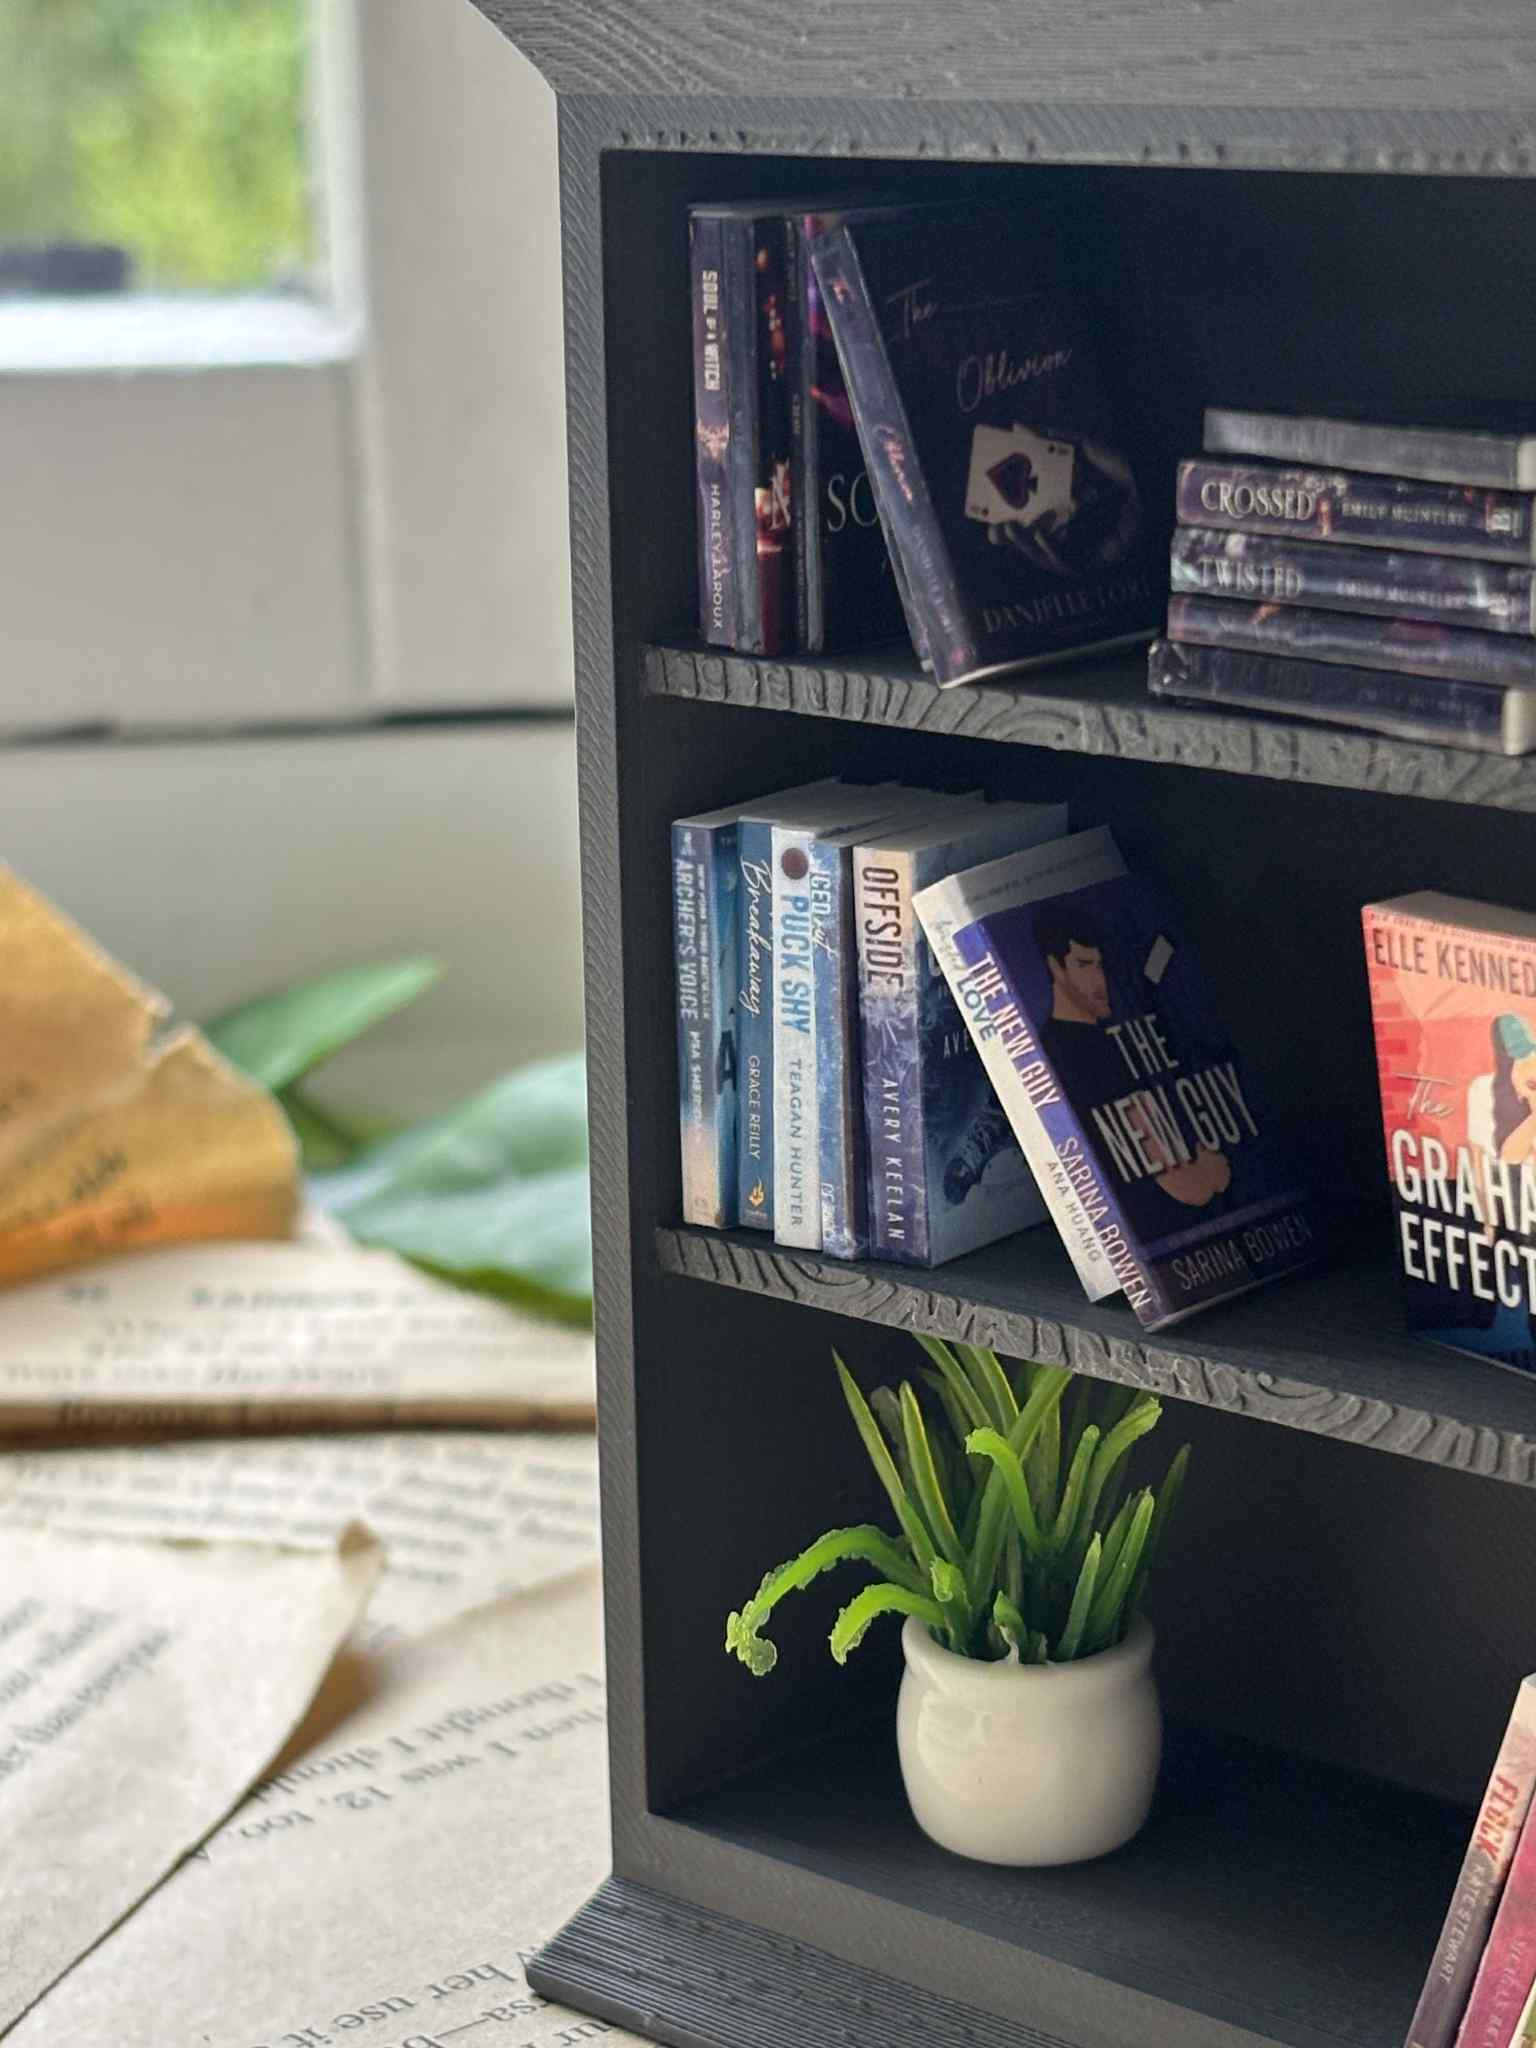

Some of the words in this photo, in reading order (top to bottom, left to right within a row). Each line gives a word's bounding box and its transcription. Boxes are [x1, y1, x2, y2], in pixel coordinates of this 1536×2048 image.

[702, 270, 720, 314] SOUL
[710, 484, 722, 552] HARLEY
[1201, 481, 1316, 521] CROSSED
[1198, 554, 1306, 599] TWISTED
[675, 858, 698, 957] ARCHER'S
[739, 856, 773, 1017] Breakaway
[780, 895, 811, 975] PUCK
[862, 866, 904, 989] OFFSIDE
[1373, 927, 1428, 976] ELLE
[679, 960, 700, 1020] VOICE
[781, 979, 811, 1034] SHY
[1104, 1014, 1179, 1080] THE
[748, 1055, 760, 1107] GRACE
[789, 1059, 802, 1139] TEAGAN
[882, 1078, 902, 1144] AVERY
[957, 976, 998, 1041] LOVE
[1047, 1161, 1070, 1197] ANA
[1396, 1073, 1456, 1120] The
[749, 1112, 761, 1161] REILLY
[966, 951, 1008, 1004] THE
[992, 1002, 1036, 1061] NEW
[1019, 1060, 1061, 1109] GUY
[1057, 1137, 1110, 1223] SARINA
[1099, 1223, 1152, 1310] BOWEN
[1091, 1085, 1192, 1183] NEW
[1175, 1062, 1259, 1151] GUY
[790, 1150, 804, 1226] HUNTER
[885, 1156, 905, 1240] KEELAN
[1171, 1239, 1249, 1290] SARINA
[1242, 1211, 1313, 1263] BOWEN
[1400, 1210, 1536, 1316] EFFECT
[1476, 1774, 1520, 1863] FLOCK
[333, 1995, 420, 2030] use
[427, 1961, 519, 2000] her
[281, 2025, 334, 2048] it
